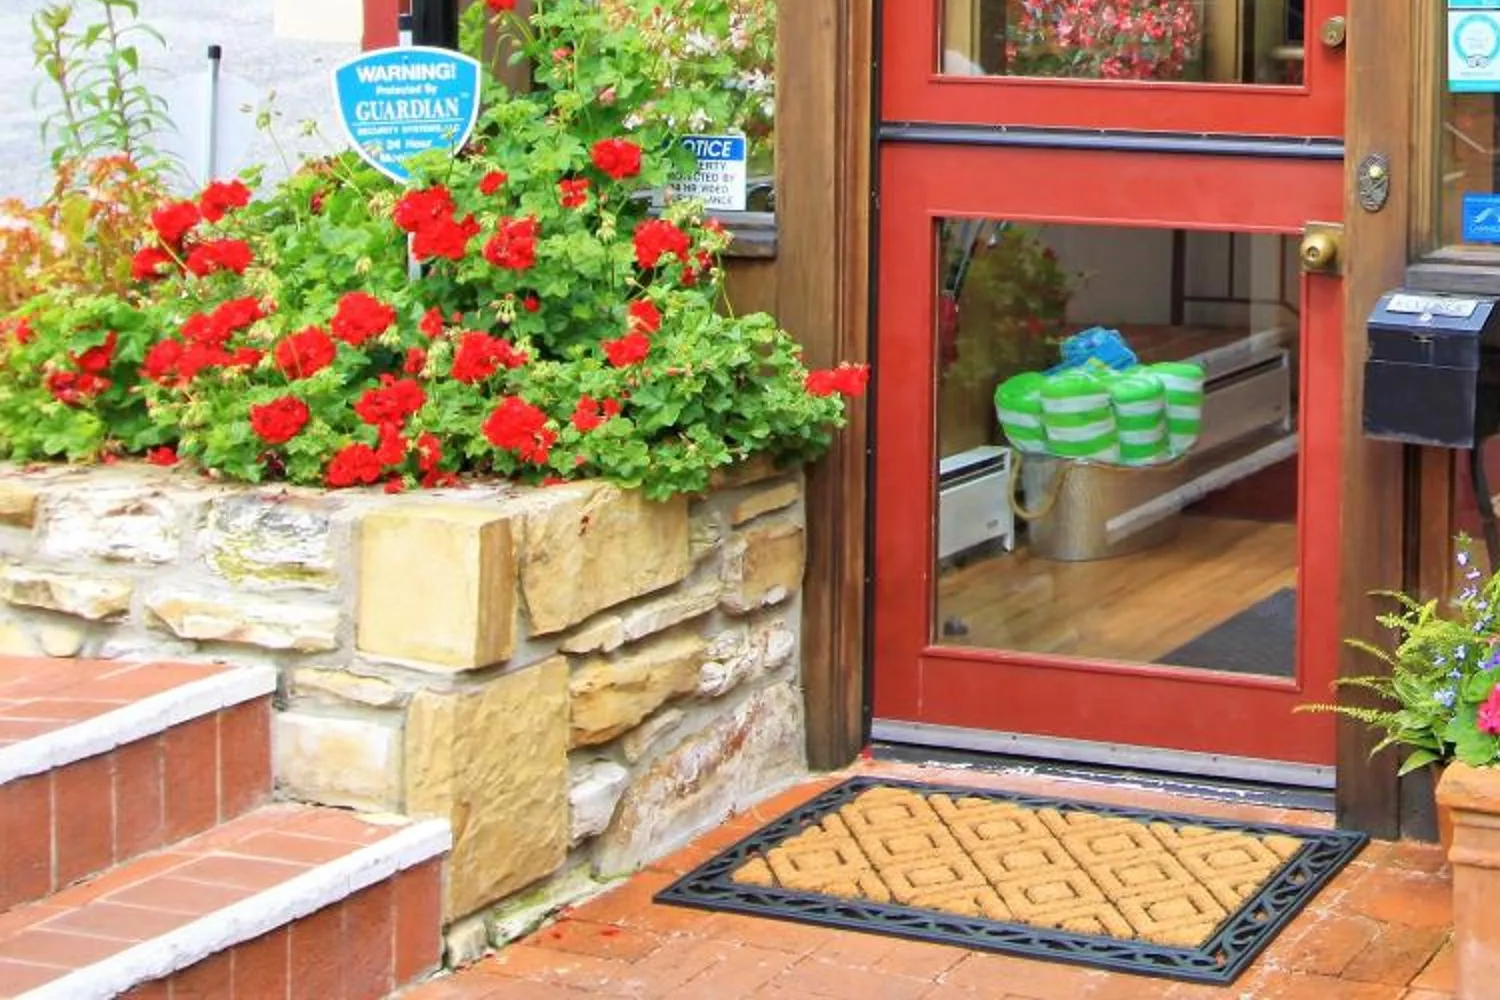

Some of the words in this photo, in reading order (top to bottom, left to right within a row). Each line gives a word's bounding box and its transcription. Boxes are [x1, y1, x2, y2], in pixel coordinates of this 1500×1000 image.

[356, 62, 457, 83] WARNING!
[355, 97, 459, 121] GUARDIAN
[682, 139, 732, 158] OTICE
